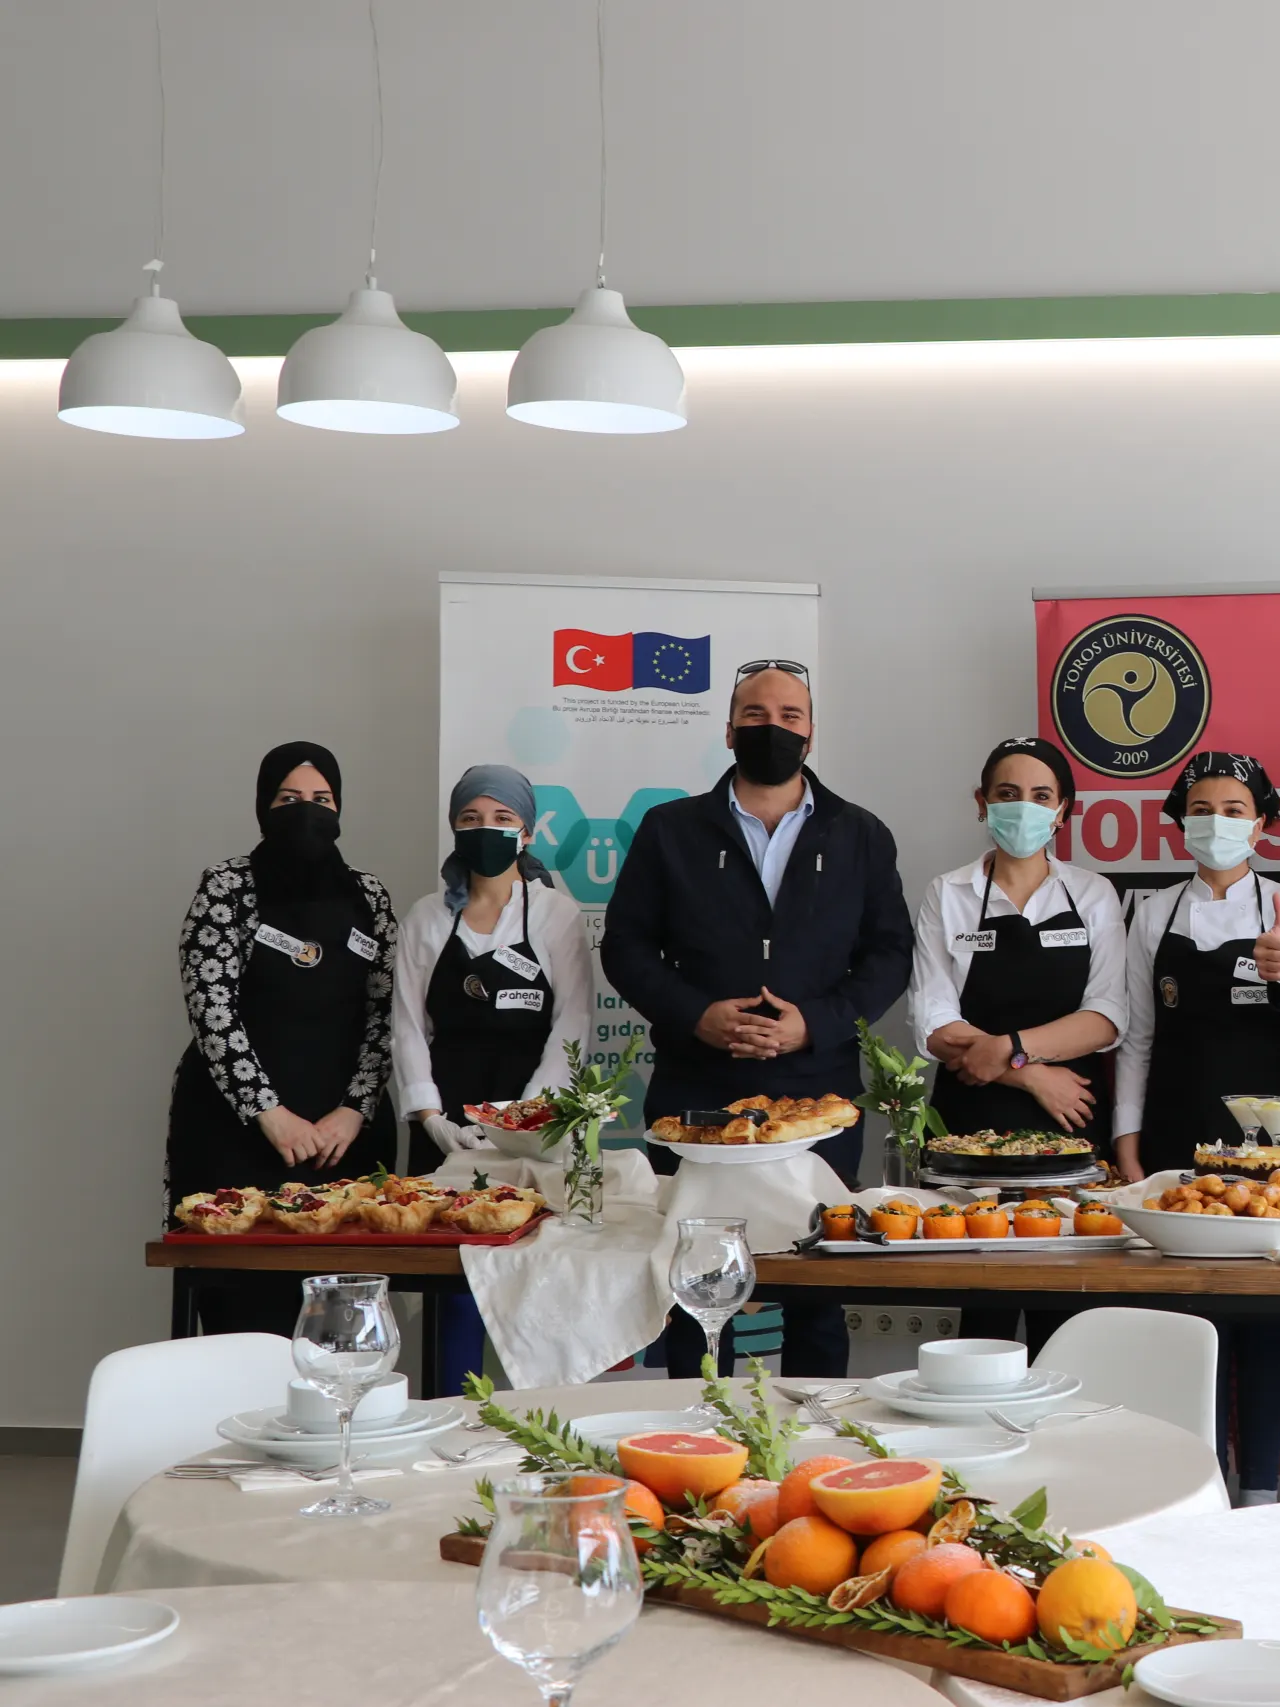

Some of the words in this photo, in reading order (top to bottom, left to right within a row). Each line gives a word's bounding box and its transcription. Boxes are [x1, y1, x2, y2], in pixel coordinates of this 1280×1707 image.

[1063, 641, 1102, 692] TOROS
[1102, 629, 1198, 689] ÜNİVERSİTESİ
[577, 698, 599, 706] project
[650, 700, 680, 708] European
[1112, 750, 1149, 766] 2009
[965, 932, 993, 942] ahenk
[509, 991, 541, 1001] ahenk
